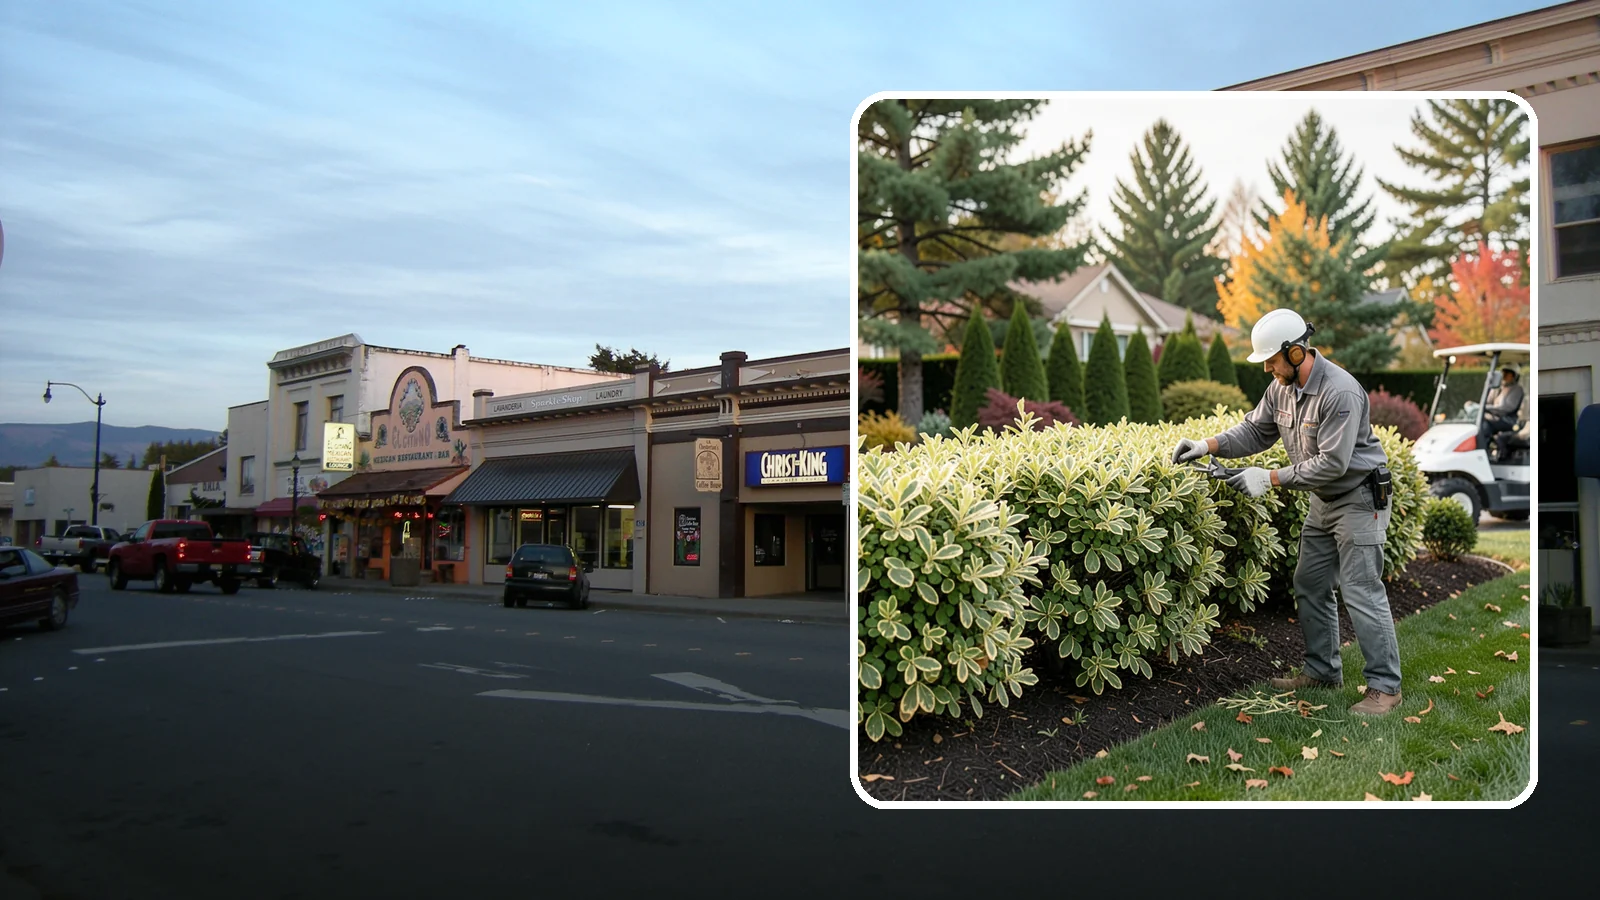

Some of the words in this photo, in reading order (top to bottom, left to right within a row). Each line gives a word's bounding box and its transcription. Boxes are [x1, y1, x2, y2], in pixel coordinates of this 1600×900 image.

[595, 388, 624, 399] LAUNDRY
[493, 402, 523, 412] LAVANDERIA
[530, 396, 560, 409] Sparkle
[561, 394, 583, 406] Shop
[373, 454, 396, 464] MEXICAN
[397, 451, 433, 462] RESTAURANT
[438, 450, 450, 459] BAR
[761, 452, 797, 477] CHRIST
[799, 450, 827, 476] KING
